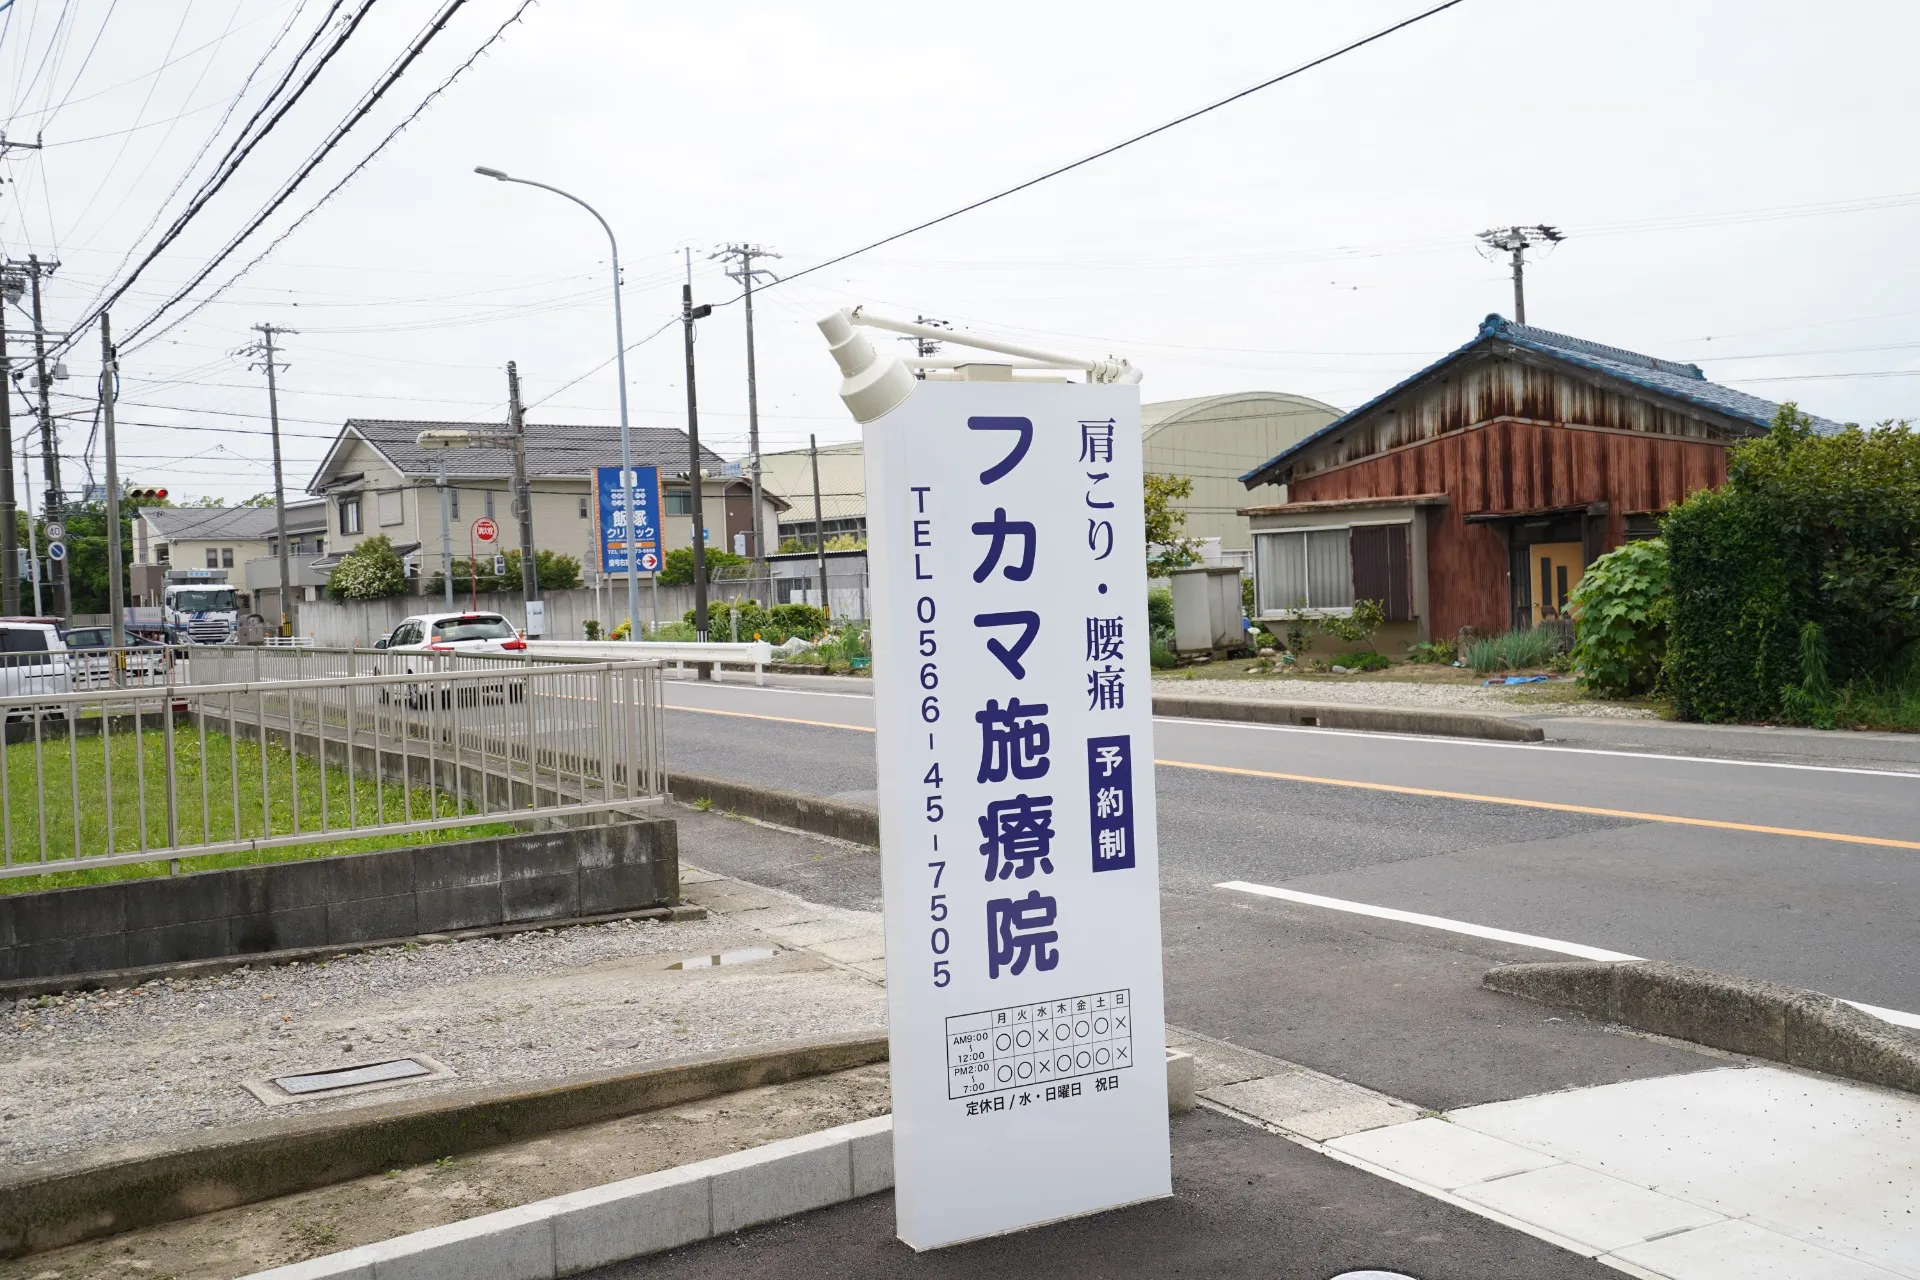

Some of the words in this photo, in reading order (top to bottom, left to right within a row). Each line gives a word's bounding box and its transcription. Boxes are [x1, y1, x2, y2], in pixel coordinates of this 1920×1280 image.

[49, 527, 60, 536] 40
[607, 527, 654, 539] クリック
[911, 487, 935, 581] TEL
[1078, 418, 1125, 711] 肩こり・腰痛
[968, 417, 1059, 979] フカマ施療院
[917, 596, 951, 988] 0566-45-7505
[1095, 746, 1125, 860] 予約制
[997, 1013, 1006, 1024] 月
[1017, 1010, 1027, 1021] 火
[1037, 1006, 1047, 1017] 水
[1057, 1003, 1067, 1014] 木
[1077, 1000, 1087, 1011] 金
[1096, 997, 1106, 1008] 土
[1116, 994, 1124, 1005] 日
[953, 1032, 989, 1045] AM9:00
[958, 1052, 985, 1063] 12:00
[954, 1063, 989, 1076] PM2:00
[963, 1082, 985, 1093] 7:00
[1095, 1075, 1119, 1092] 祝日
